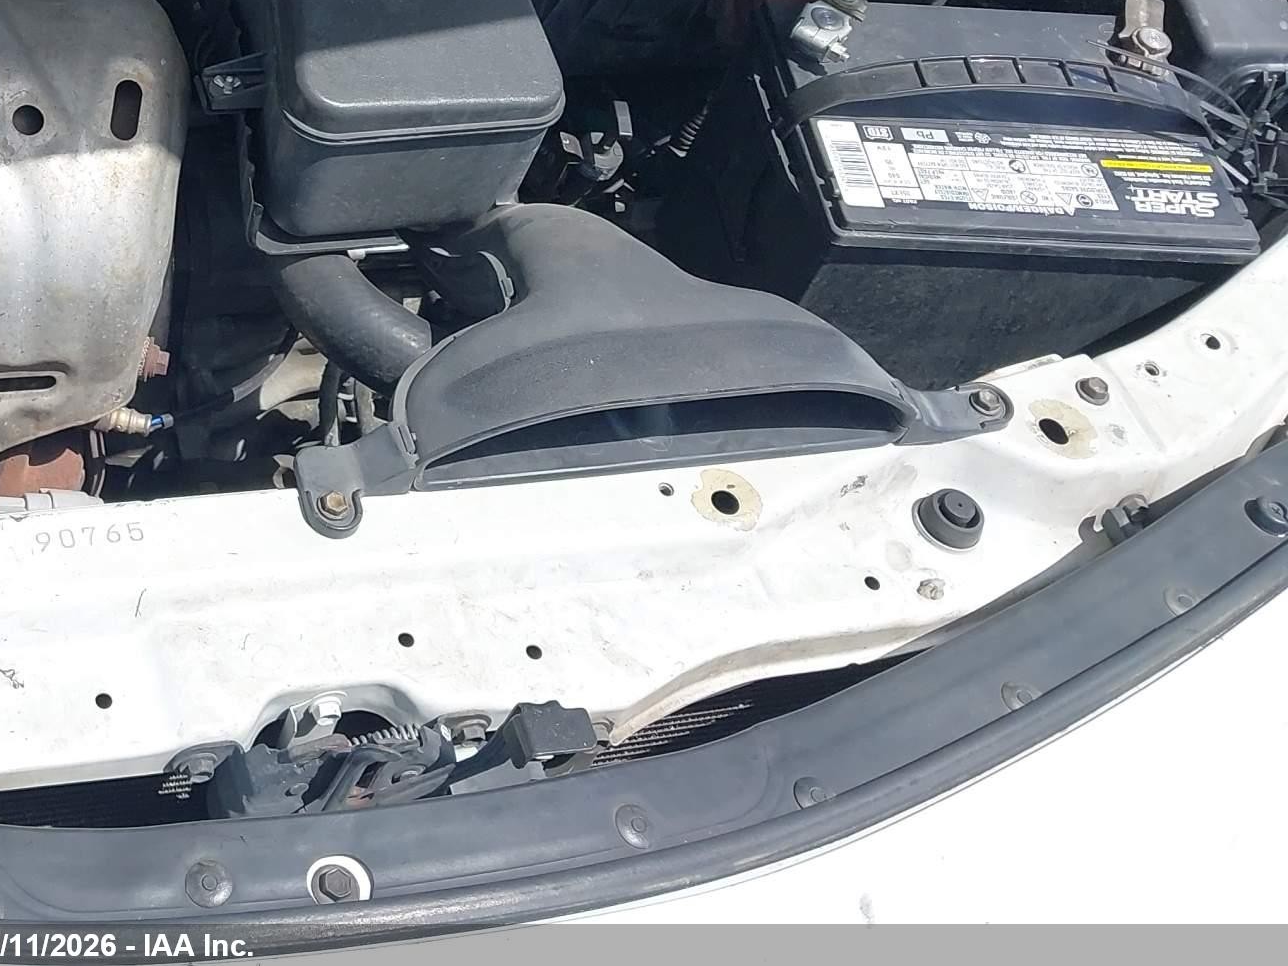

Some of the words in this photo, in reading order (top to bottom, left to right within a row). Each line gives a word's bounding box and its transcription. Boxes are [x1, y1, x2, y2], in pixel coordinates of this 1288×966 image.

[1126, 189, 1220, 207] START
[1133, 201, 1216, 219] SUPER
[34, 521, 145, 554] 90765
